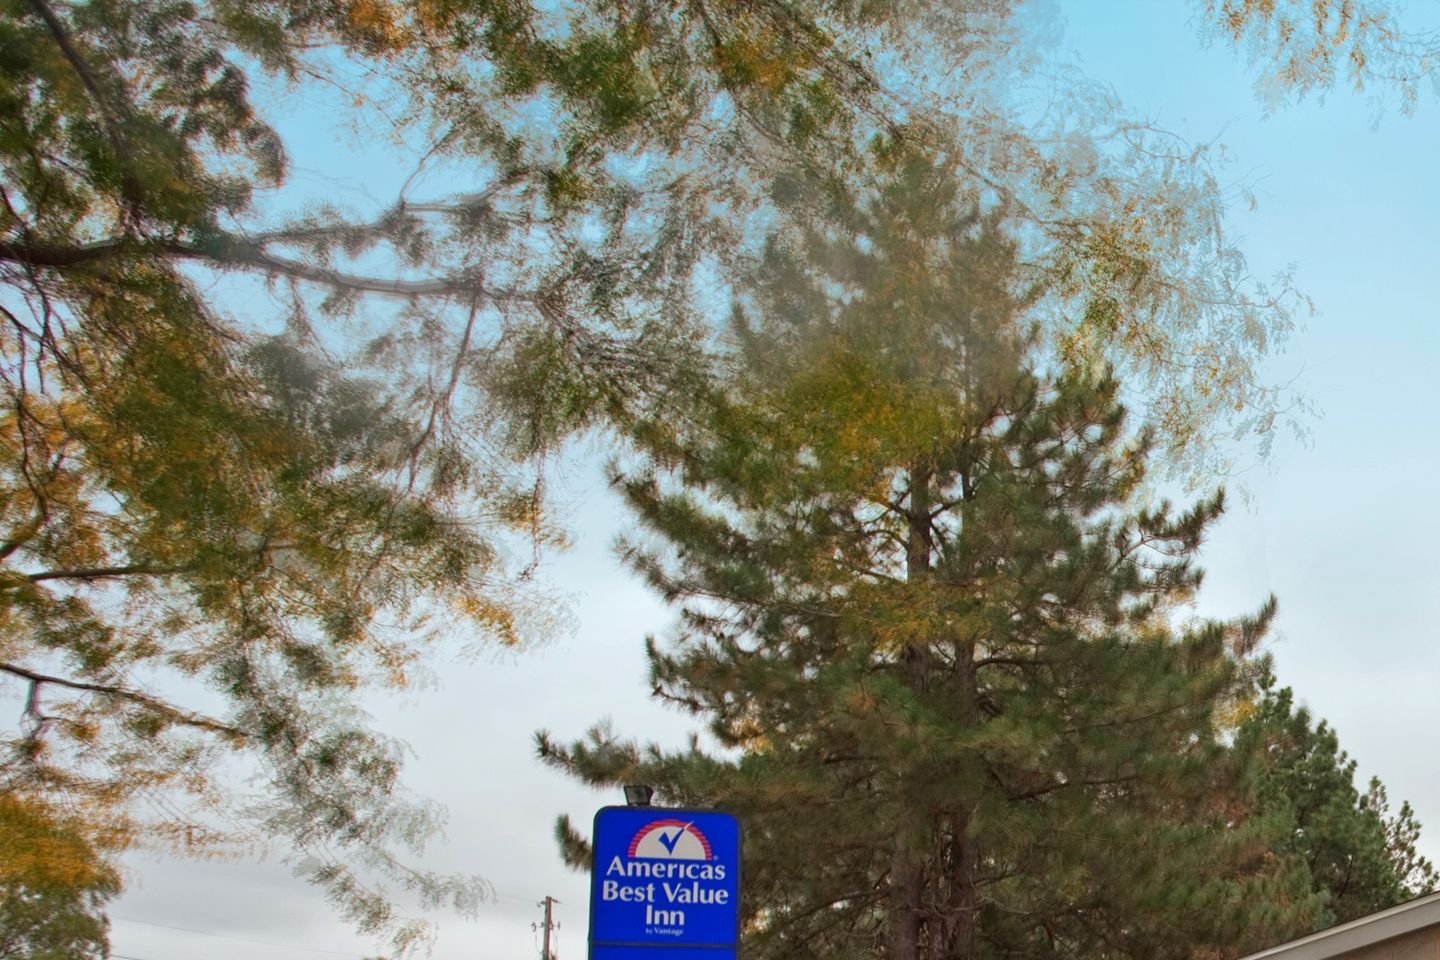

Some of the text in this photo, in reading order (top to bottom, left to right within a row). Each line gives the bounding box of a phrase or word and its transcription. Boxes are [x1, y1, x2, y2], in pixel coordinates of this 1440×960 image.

[606, 855, 726, 880] Americas
[602, 880, 729, 904] Best Value
[645, 904, 685, 926] Inn
[654, 927, 684, 936] Vantage
